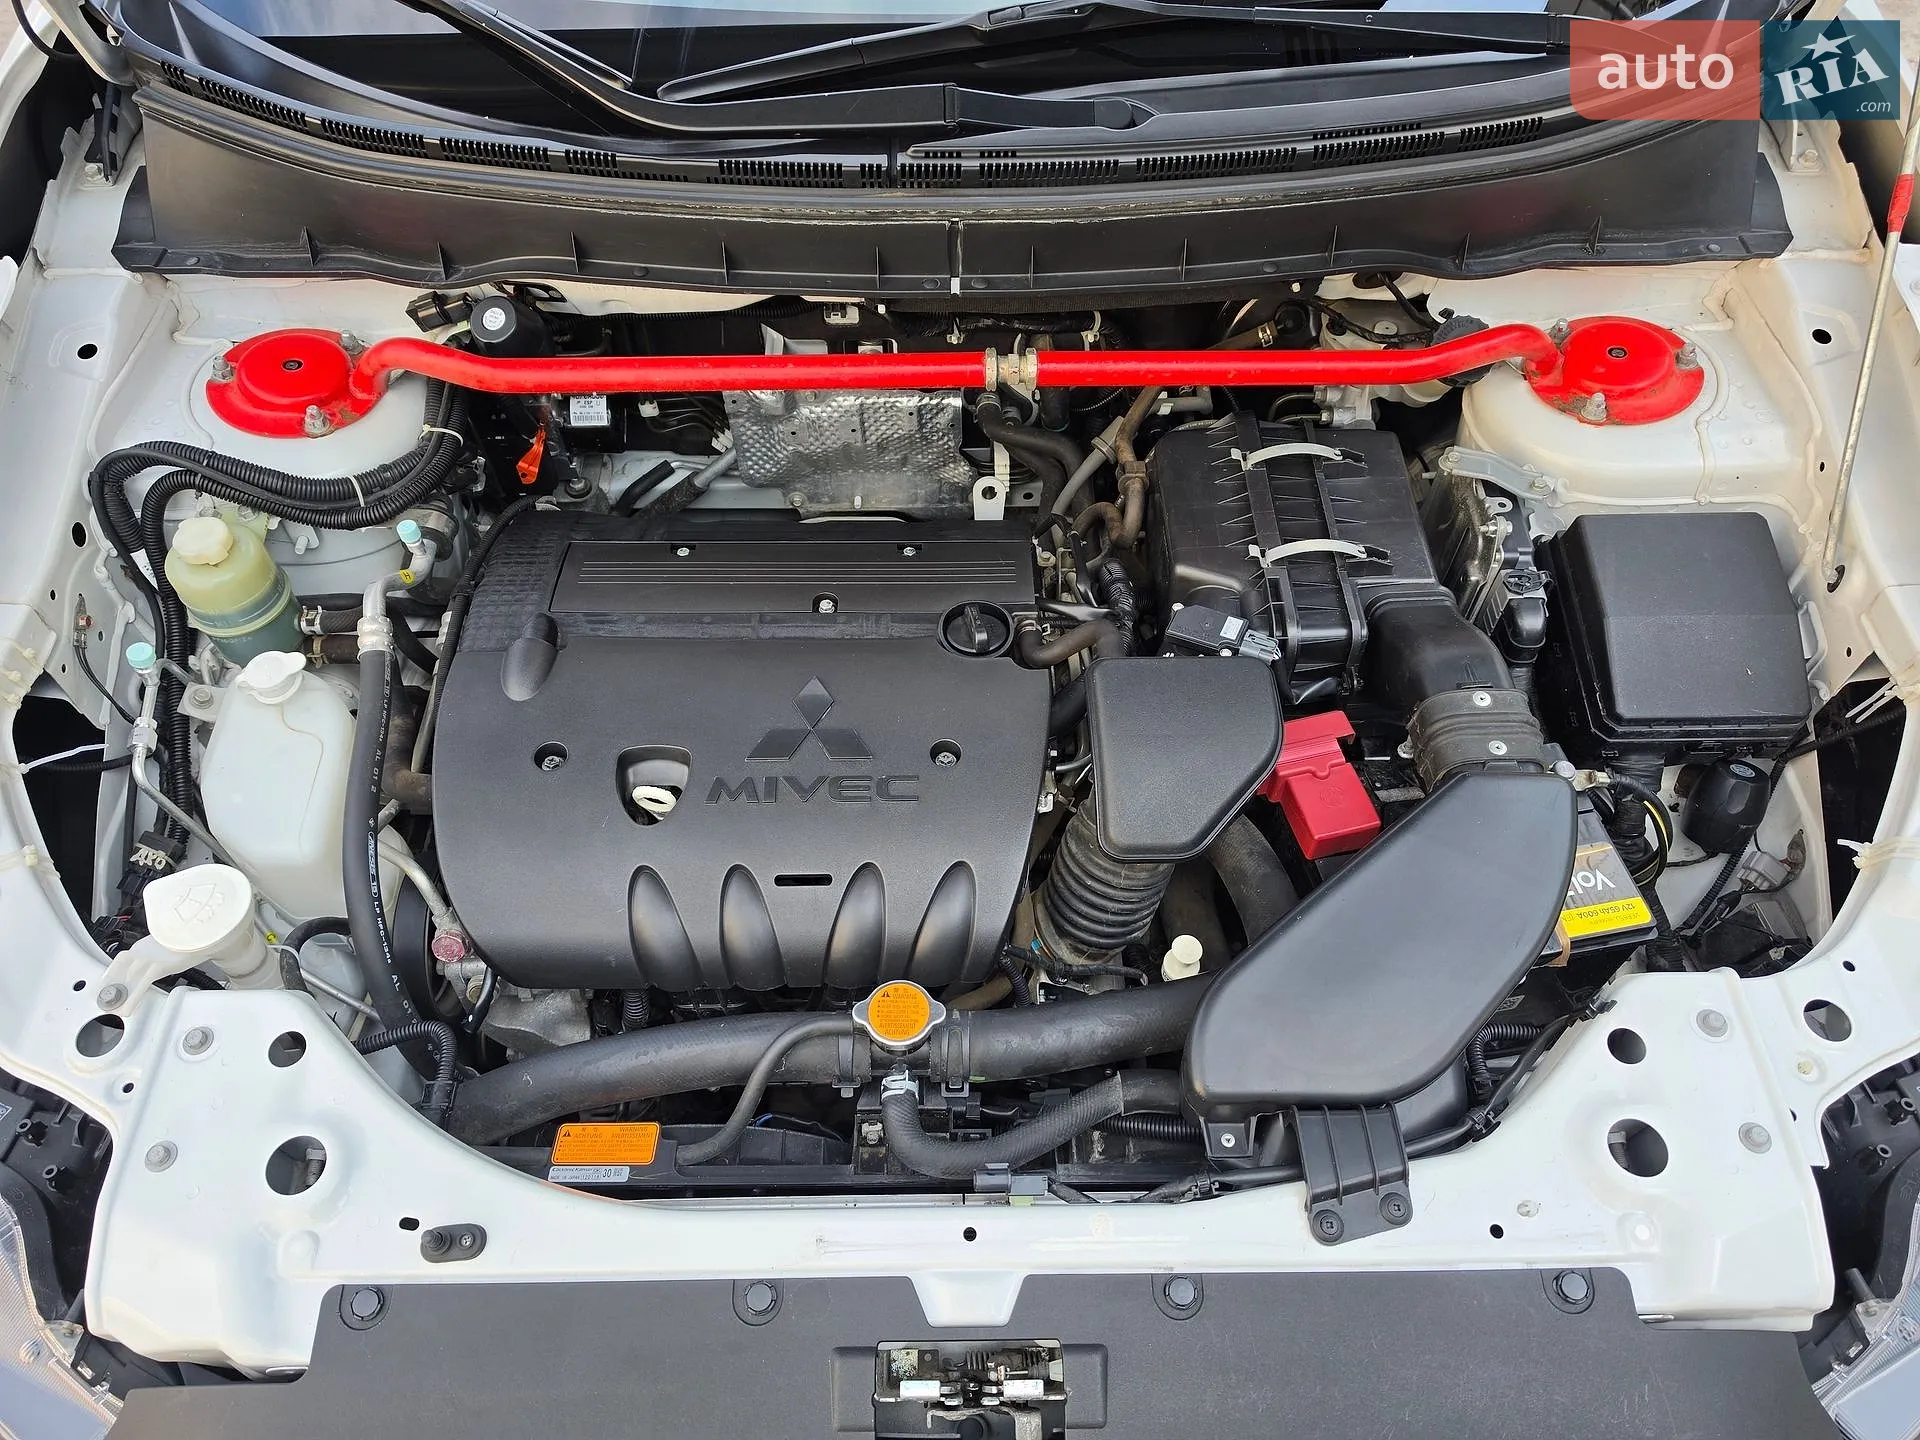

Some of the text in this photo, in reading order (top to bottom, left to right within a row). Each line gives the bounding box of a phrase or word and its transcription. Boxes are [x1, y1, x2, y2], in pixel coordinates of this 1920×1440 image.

[703, 775, 919, 805] MIVEC
[1621, 903, 1636, 912] 12V
[602, 1168, 612, 1178] 30
